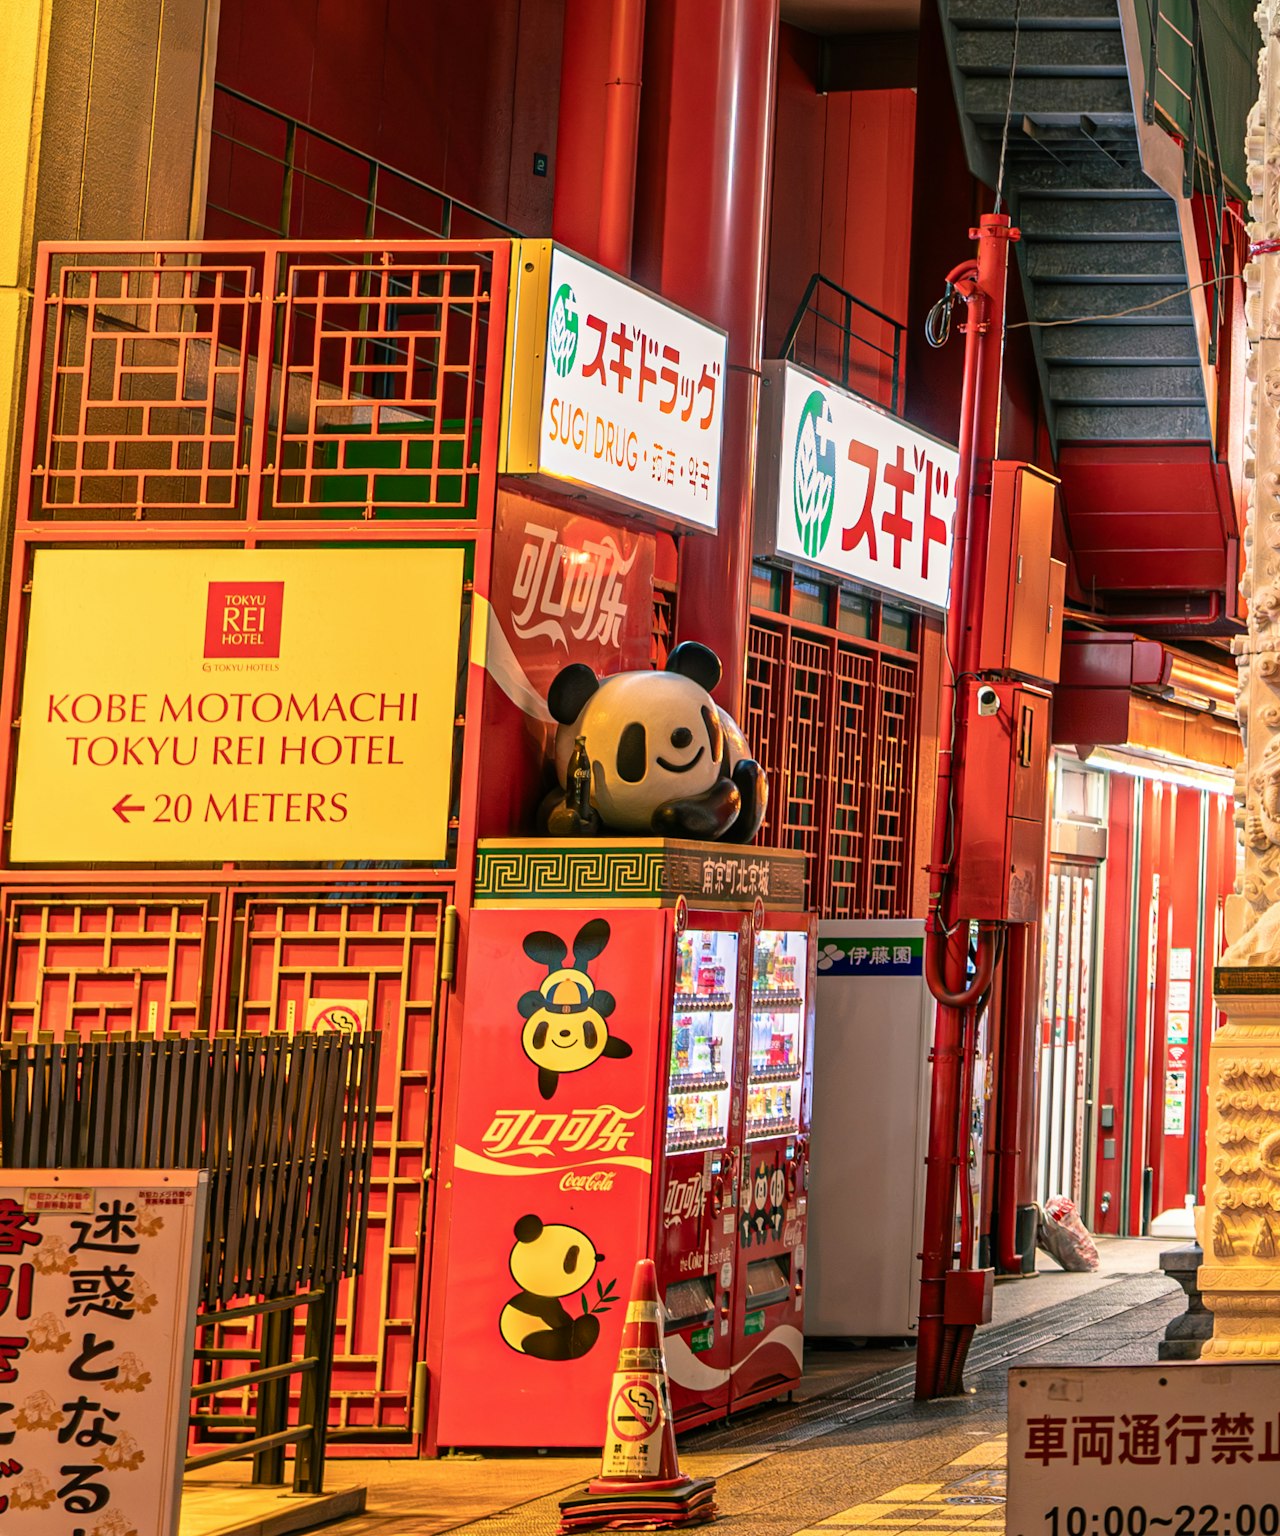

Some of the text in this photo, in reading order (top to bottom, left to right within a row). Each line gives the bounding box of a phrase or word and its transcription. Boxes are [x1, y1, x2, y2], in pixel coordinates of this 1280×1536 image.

[582, 313, 721, 431] スギドラッグ
[548, 397, 589, 453] SUGI
[595, 416, 639, 473] DRUG
[225, 595, 266, 606] TOKYU
[222, 607, 265, 633] REI
[222, 633, 265, 645] HOTEL
[214, 663, 280, 672] TOKYU HOTELS
[47, 692, 419, 723] KOBE MOTOMACHI
[66, 735, 404, 765] TOKYU REI HOTEL
[152, 792, 349, 823] 20 METERS
[702, 857, 770, 897] 南京町北京城
[847, 946, 912, 965] 伊藤園
[58, 1199, 141, 1536] 迷惑となる
